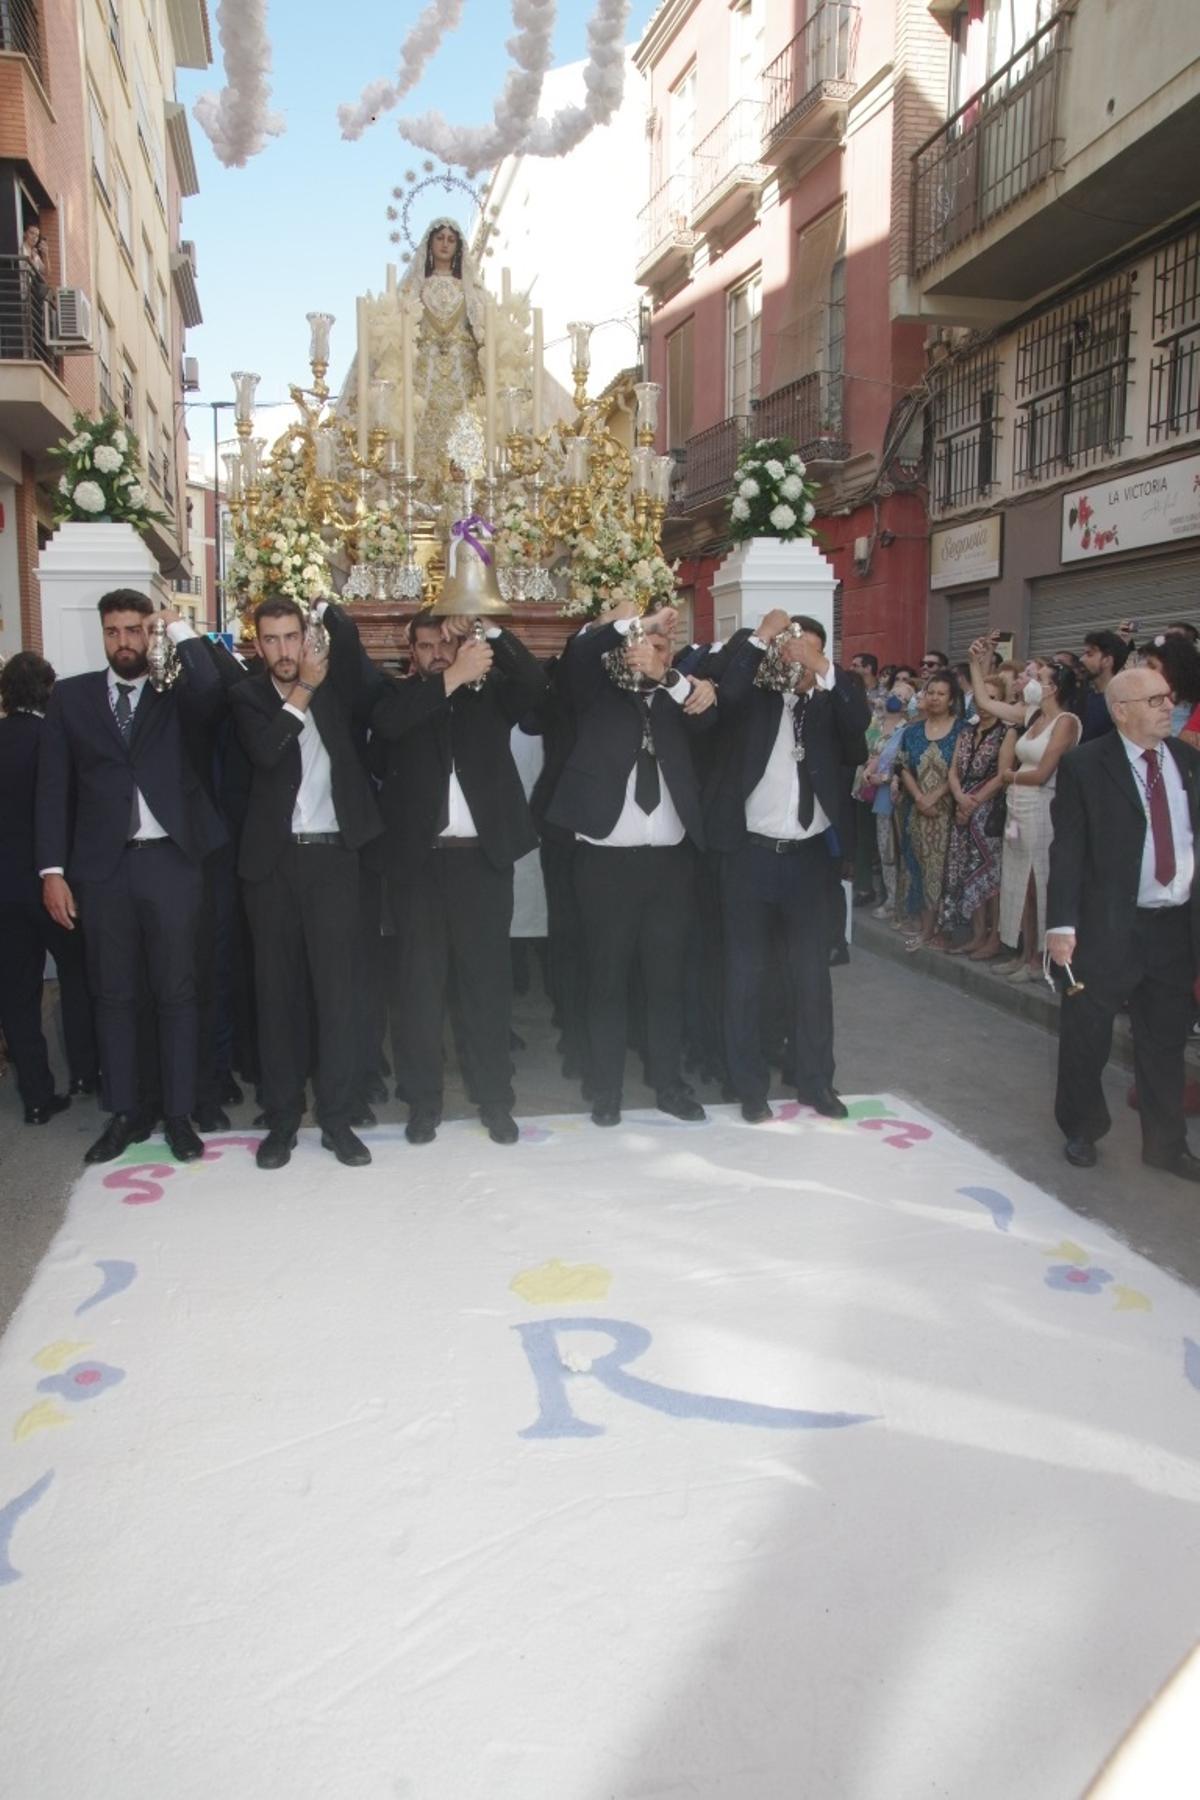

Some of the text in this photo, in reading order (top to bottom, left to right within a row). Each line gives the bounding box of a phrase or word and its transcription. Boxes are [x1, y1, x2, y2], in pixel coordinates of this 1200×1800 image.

[1108, 477, 1168, 505] LA VICTORIA
[510, 1317, 885, 1439] R
